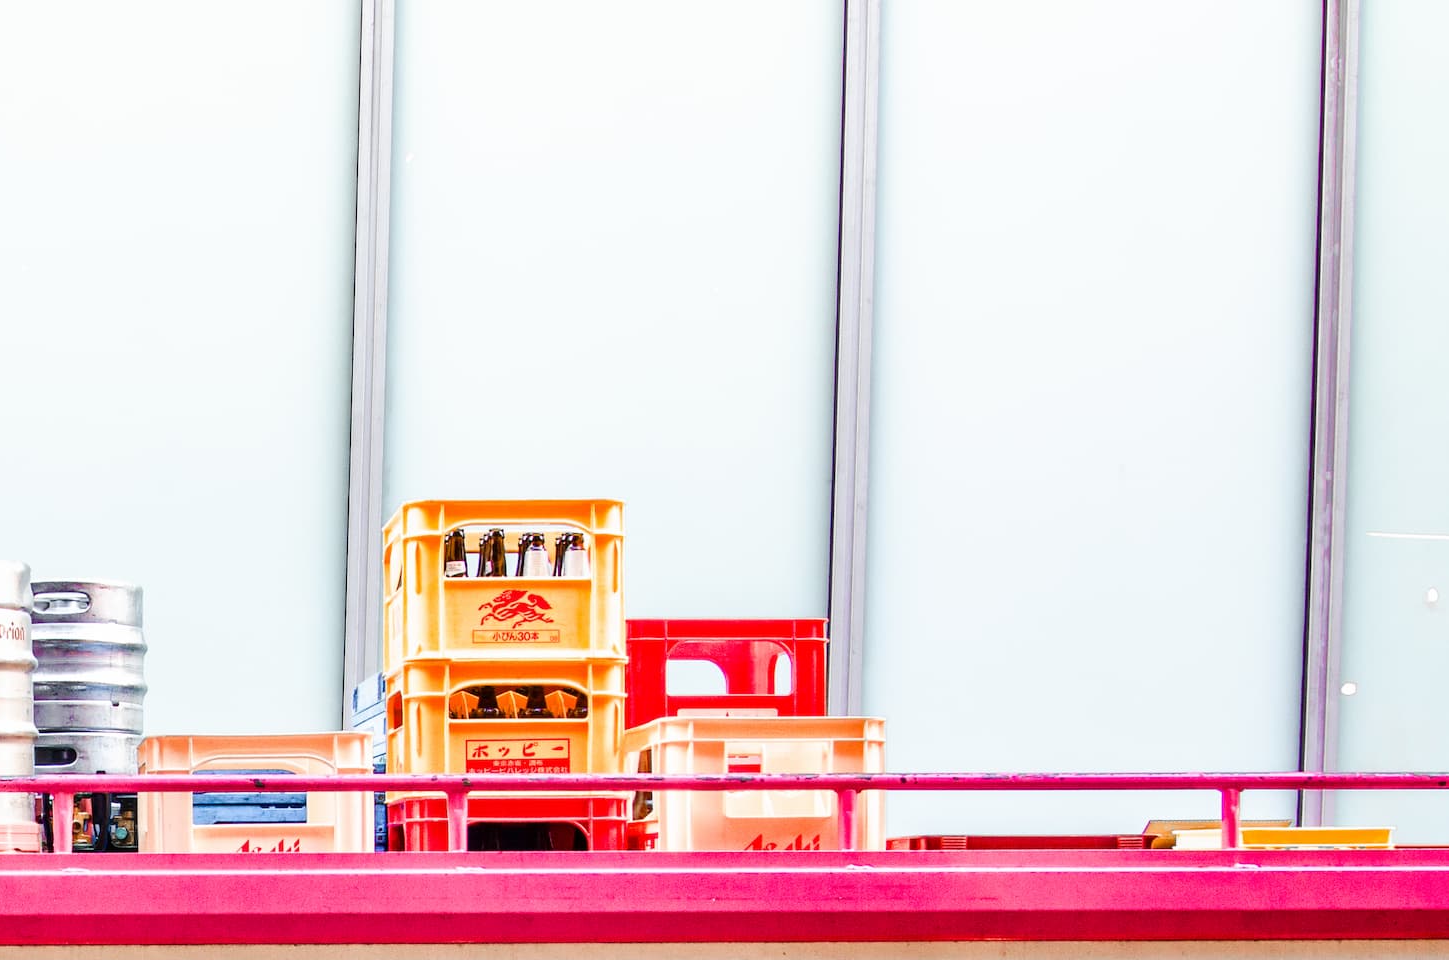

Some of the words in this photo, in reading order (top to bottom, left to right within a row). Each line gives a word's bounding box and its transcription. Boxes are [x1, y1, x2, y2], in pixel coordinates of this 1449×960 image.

[492, 631, 540, 642] 小びん30本
[471, 741, 565, 758] ホッピー
